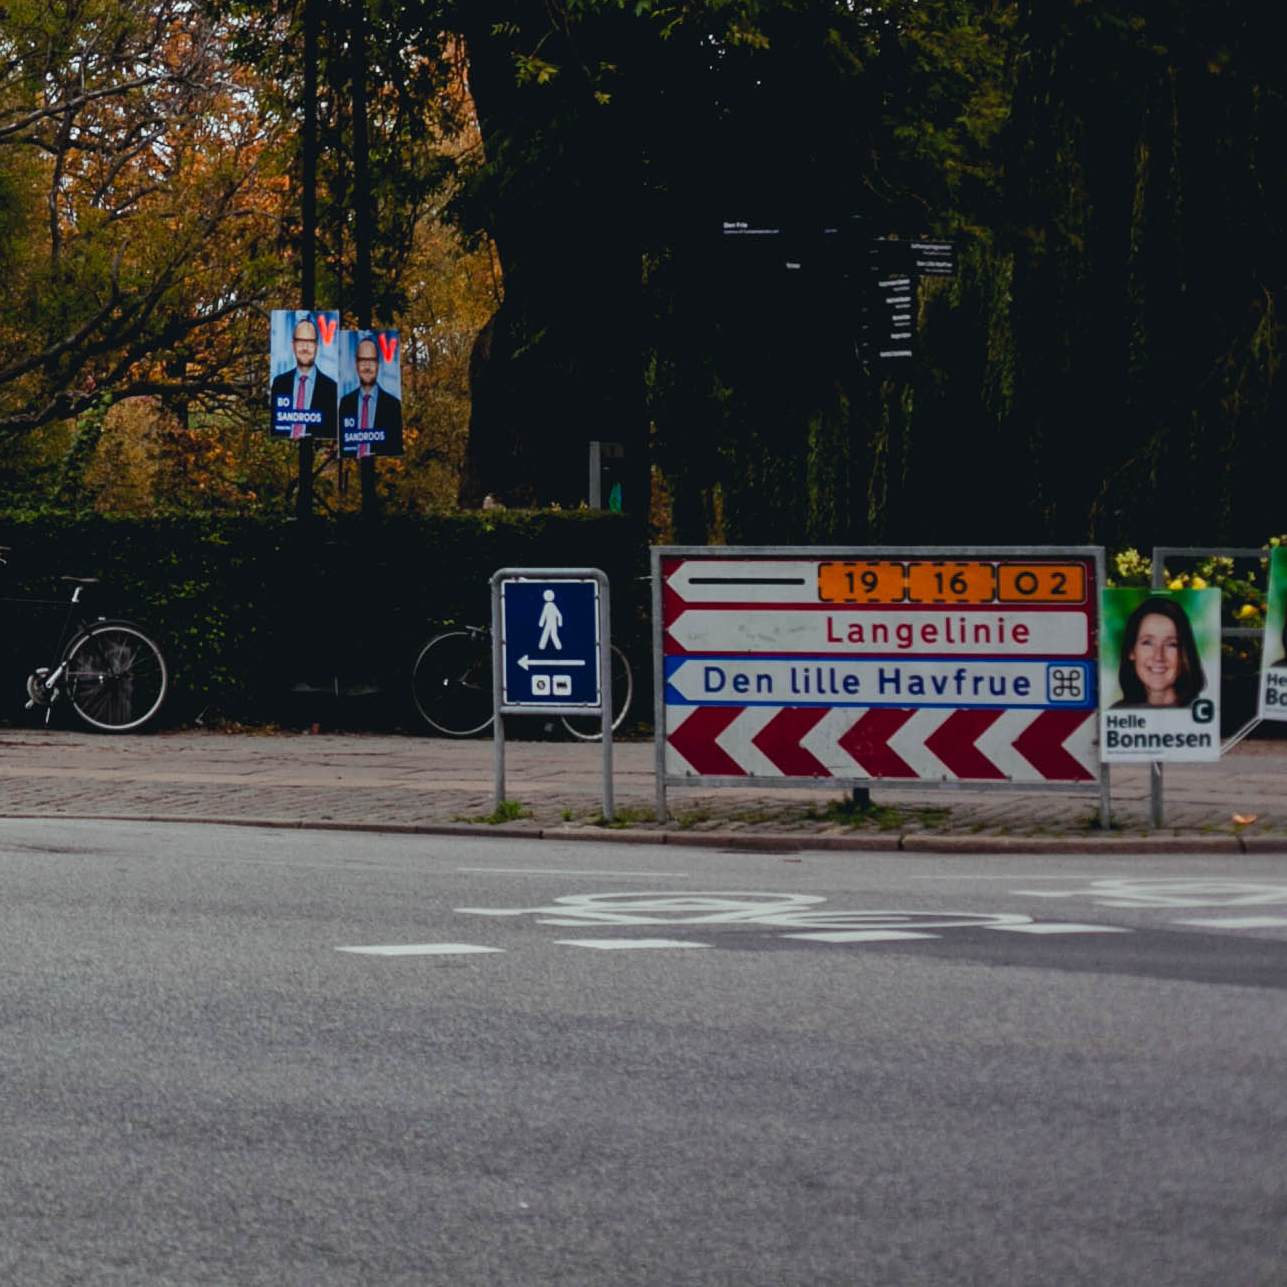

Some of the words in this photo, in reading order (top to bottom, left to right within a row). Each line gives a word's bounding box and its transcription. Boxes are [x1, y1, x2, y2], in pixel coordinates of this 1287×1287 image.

[317, 315, 337, 345] V
[378, 333, 397, 363] V
[277, 397, 290, 407] BO
[277, 412, 322, 423] SANDROOS
[344, 418, 355, 427] BO
[344, 431, 385, 442] SANDROOS
[844, 571, 879, 594] 19
[934, 571, 968, 595] 16
[827, 616, 1031, 650] Langelinie
[704, 666, 773, 694] Den
[790, 666, 861, 695] lille
[877, 668, 1032, 697] Havfrue
[1106, 715, 1146, 729] Helle
[1106, 730, 1211, 748] Bonnesen
